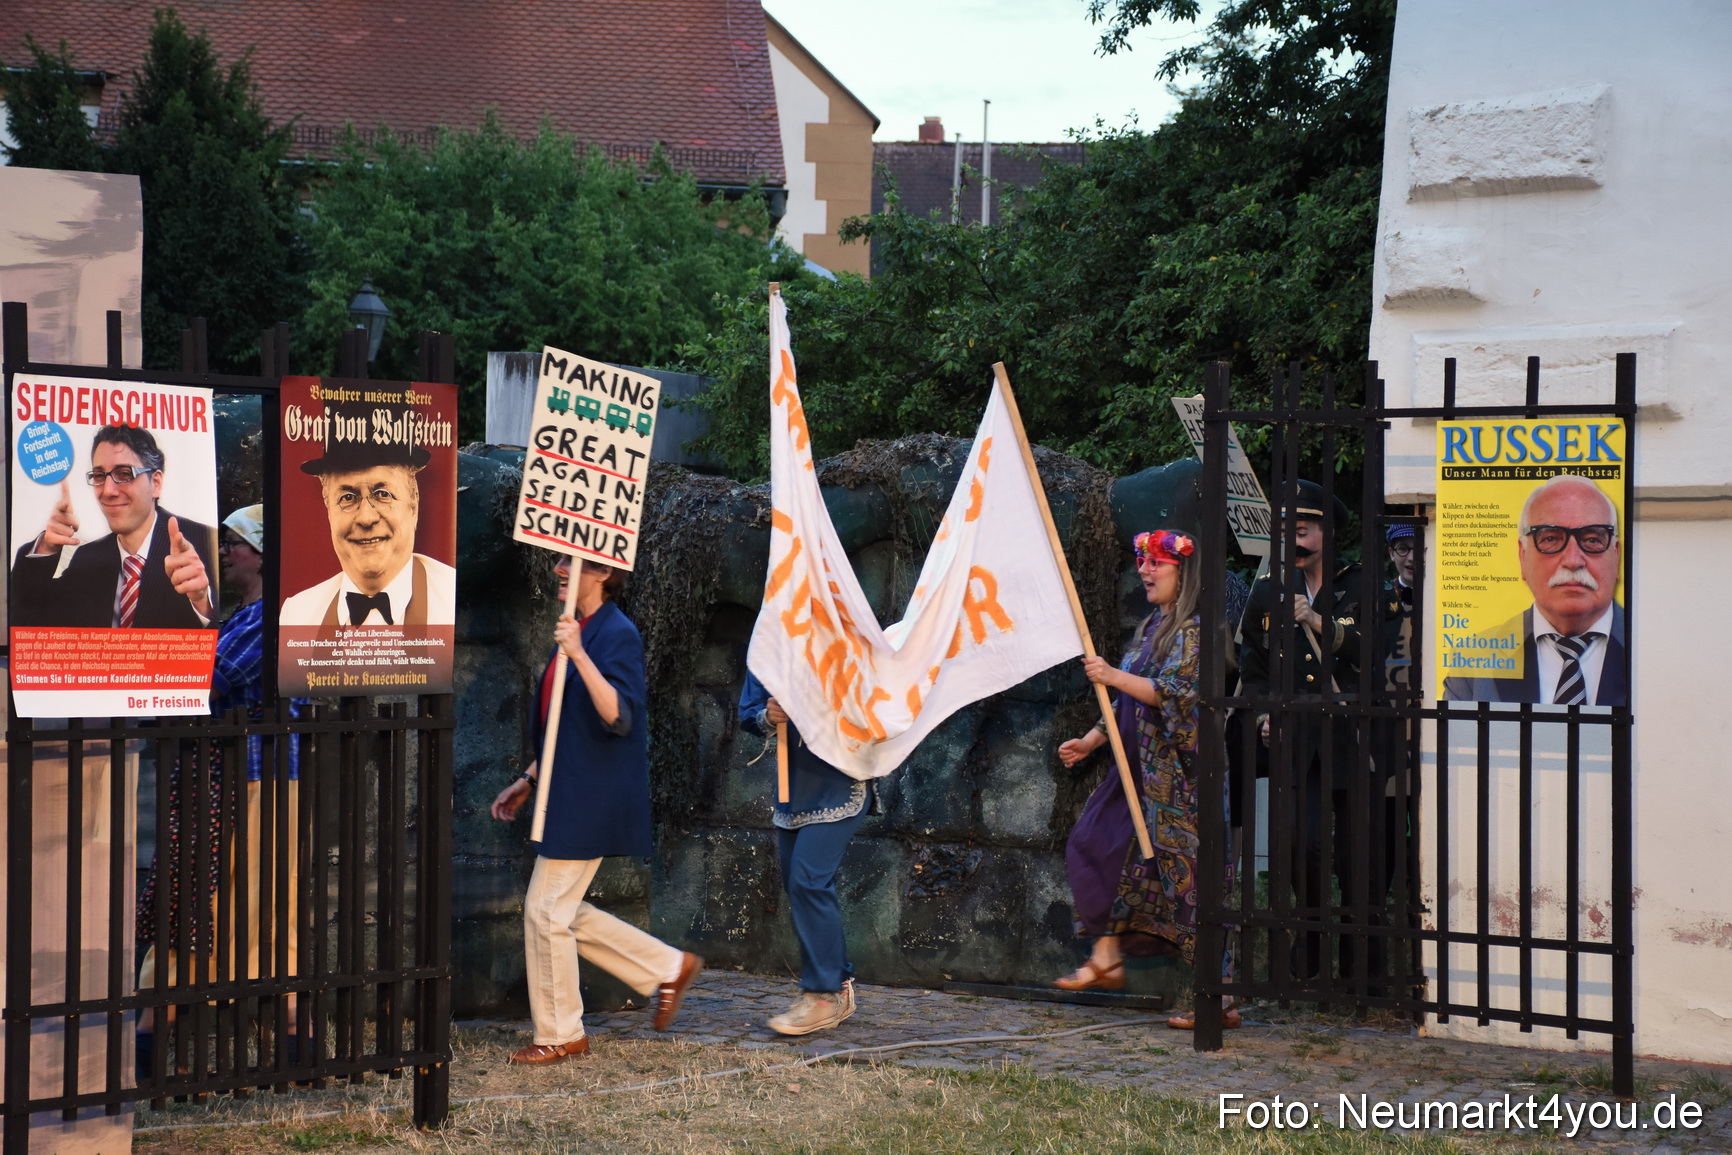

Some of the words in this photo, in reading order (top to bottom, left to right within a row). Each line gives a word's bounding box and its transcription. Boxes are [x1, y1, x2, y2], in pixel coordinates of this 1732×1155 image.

[543, 352, 655, 410] MAKING
[310, 384, 361, 405] Bewahrer
[364, 389, 402, 403] unserer
[405, 390, 433, 405] Werte
[17, 382, 208, 433] SEIDENSCHNUR
[27, 422, 50, 438] Bringt
[284, 404, 331, 453] Graf
[335, 411, 367, 444] von
[372, 408, 452, 456] Wolfstein
[23, 432, 62, 454] Fortschritt
[1441, 424, 1622, 463] RUSSEK
[34, 453, 44, 464] in
[44, 449, 59, 461] den
[534, 425, 646, 479] GREAT
[31, 457, 70, 479] Reichstag!
[1444, 467, 1476, 478] Unser
[1480, 467, 1510, 478] Mann
[1514, 466, 1531, 477] für
[1535, 466, 1556, 477] den
[1561, 466, 1620, 479] Reichstag
[530, 457, 641, 505] AGAIN:
[525, 478, 636, 526] SEIDEN-
[520, 507, 629, 562] SCHNUR
[1442, 613, 1469, 629] Die
[15, 631, 36, 640] Wähler
[37, 631, 48, 640] des
[50, 632, 80, 641] Freisinns,
[81, 632, 89, 640] im
[90, 632, 110, 642] Kampf
[112, 634, 130, 642] gegen
[131, 632, 142, 640] den
[143, 632, 184, 642] Absolutismus,
[185, 633, 198, 641] aber
[200, 633, 214, 641] auch
[335, 630, 342, 638] Es
[343, 630, 353, 639] gilt
[354, 630, 366, 638] dem
[368, 629, 404, 638] Liberalismus,
[1442, 633, 1520, 650] National-
[15, 642, 32, 652] gegen
[34, 642, 42, 650] die
[67, 642, 76, 650] der
[310, 639, 337, 647] Drachen
[338, 639, 348, 647] der
[15, 652, 22, 660] zu
[24, 652, 33, 660] tief
[34, 652, 40, 660] in
[41, 652, 52, 660] den
[54, 652, 79, 660] Knochen
[102, 652, 112, 660] hat
[158, 652, 168, 660] der
[332, 648, 344, 656] den
[344, 648, 373, 656] Wahlkreis
[15, 662, 30, 670] Geist
[30, 662, 39, 670] die
[64, 662, 68, 670] in
[70, 662, 80, 670] den
[82, 662, 110, 671] Reichstag
[310, 658, 346, 666] konservativ
[346, 658, 364, 666] denkt
[364, 658, 376, 666] und
[393, 657, 408, 665] wählt
[1442, 652, 1516, 669] Liberalen
[16, 674, 48, 684] Stimmen
[50, 674, 62, 684] Sie
[64, 674, 75, 684] für
[78, 675, 108, 684] unseren
[110, 674, 152, 683] Kandidaten
[154, 674, 208, 683] Seidenschnur!
[306, 672, 340, 691] Partei
[343, 672, 360, 686] der
[362, 670, 427, 686] Konservativen
[127, 696, 148, 709] Der
[152, 696, 205, 708] Freisinn.
